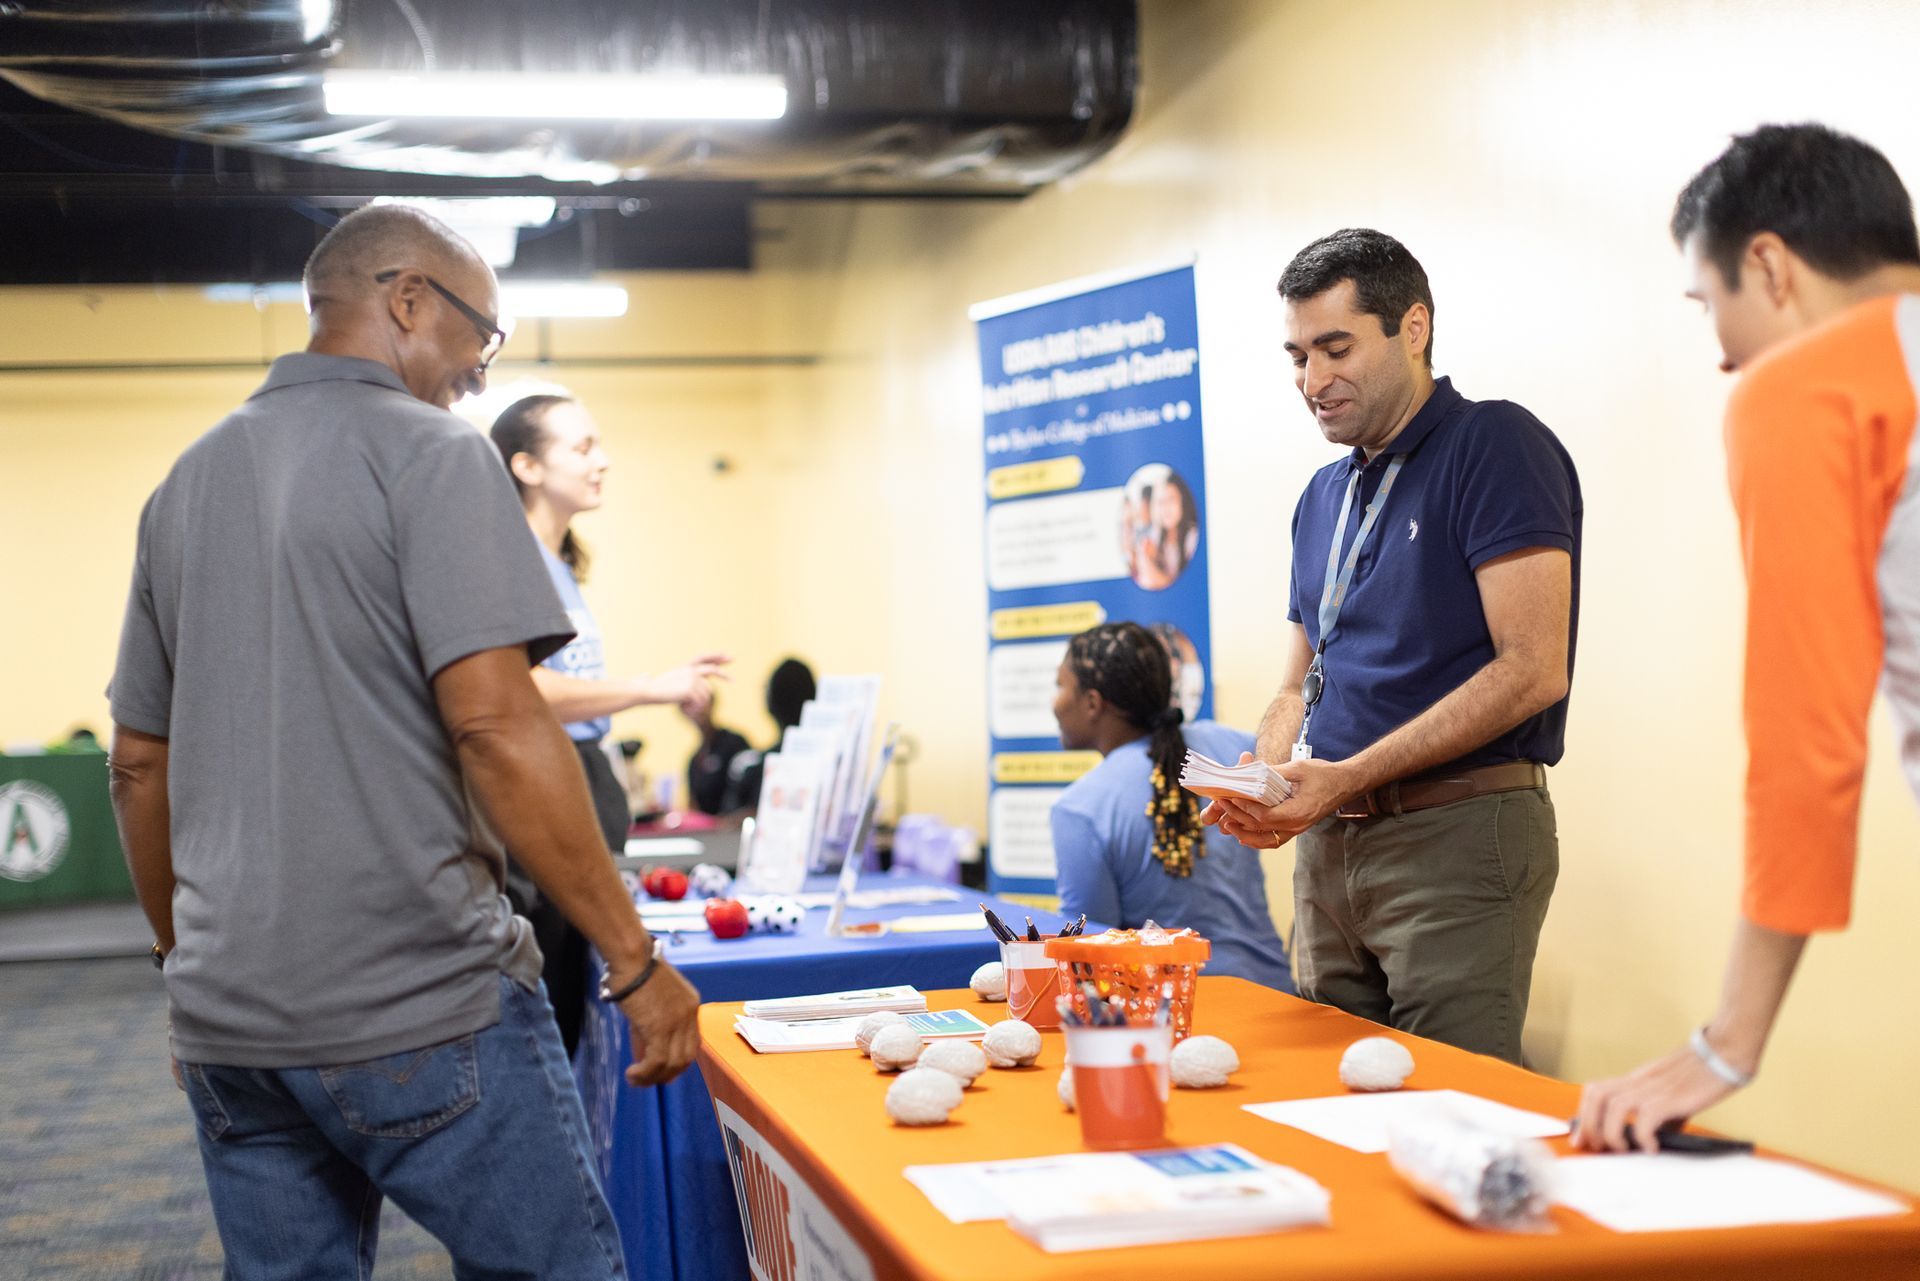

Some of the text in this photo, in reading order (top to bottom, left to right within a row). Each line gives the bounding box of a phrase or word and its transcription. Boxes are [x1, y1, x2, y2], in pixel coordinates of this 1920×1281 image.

[1078, 311, 1166, 360] Children's
[1052, 356, 1130, 400] Research
[1130, 347, 1199, 385] Center
